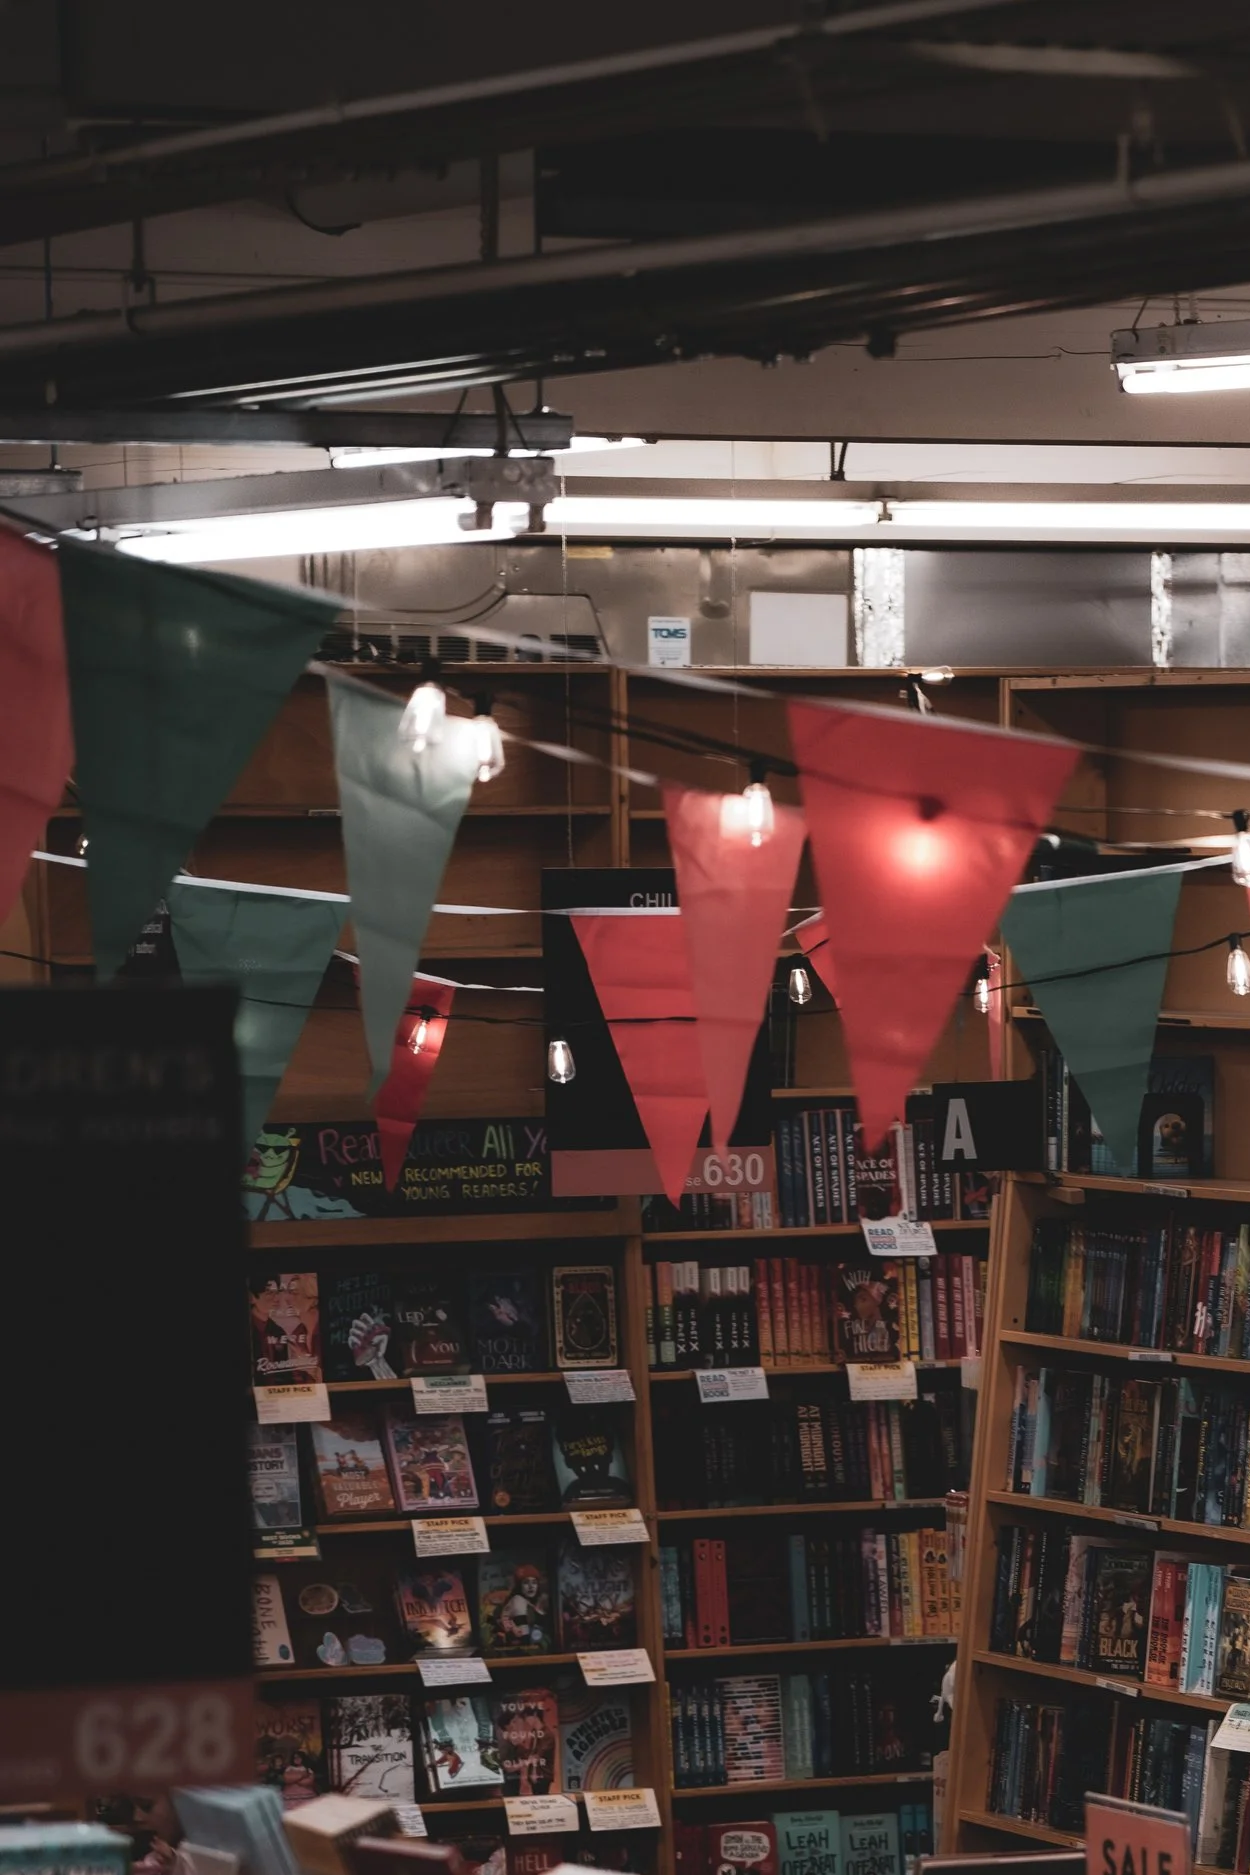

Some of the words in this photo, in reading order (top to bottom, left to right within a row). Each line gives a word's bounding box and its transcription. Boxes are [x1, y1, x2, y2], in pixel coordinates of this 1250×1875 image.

[6, 1050, 217, 1097] DREN'S
[942, 1098, 978, 1161] A
[482, 1124, 515, 1160] All
[811, 1134, 821, 1153] ACE
[827, 1134, 837, 1152] ACE
[917, 1141, 926, 1159] ACE
[405, 1163, 507, 1183] RECOMMENDED
[515, 1162, 543, 1177] FOR
[703, 1153, 764, 1187] 630
[879, 1158, 895, 1170] OF
[351, 1171, 383, 1187] NEW
[856, 1170, 896, 1181] SPADES
[401, 1183, 450, 1201] YOUNG
[462, 1180, 538, 1199] READERS!
[814, 1167, 825, 1208] SPADES
[830, 1166, 841, 1207] SPADES
[918, 1171, 927, 1207] SPADES
[397, 1311, 424, 1324] LED
[267, 1334, 307, 1345] WERE
[430, 1342, 459, 1353] YOU
[676, 1343, 687, 1354] X
[689, 1340, 699, 1351] X
[714, 1341, 724, 1350] X
[481, 1354, 533, 1370] DARK
[797, 1405, 808, 1419] AT
[808, 1404, 821, 1419] AT
[798, 1422, 814, 1473] MIDNIGHT
[810, 1421, 827, 1472] MIDNIGHT
[1099, 1637, 1139, 1659] BLACK
[501, 1701, 545, 1712] YOU'VE
[255, 1716, 317, 1736] WORST
[73, 1695, 237, 1783] 628
[502, 1731, 545, 1740] FOUND
[347, 1752, 408, 1765] TRANSITION
[785, 1829, 829, 1851] LEAH
[849, 1833, 889, 1851] LEAH
